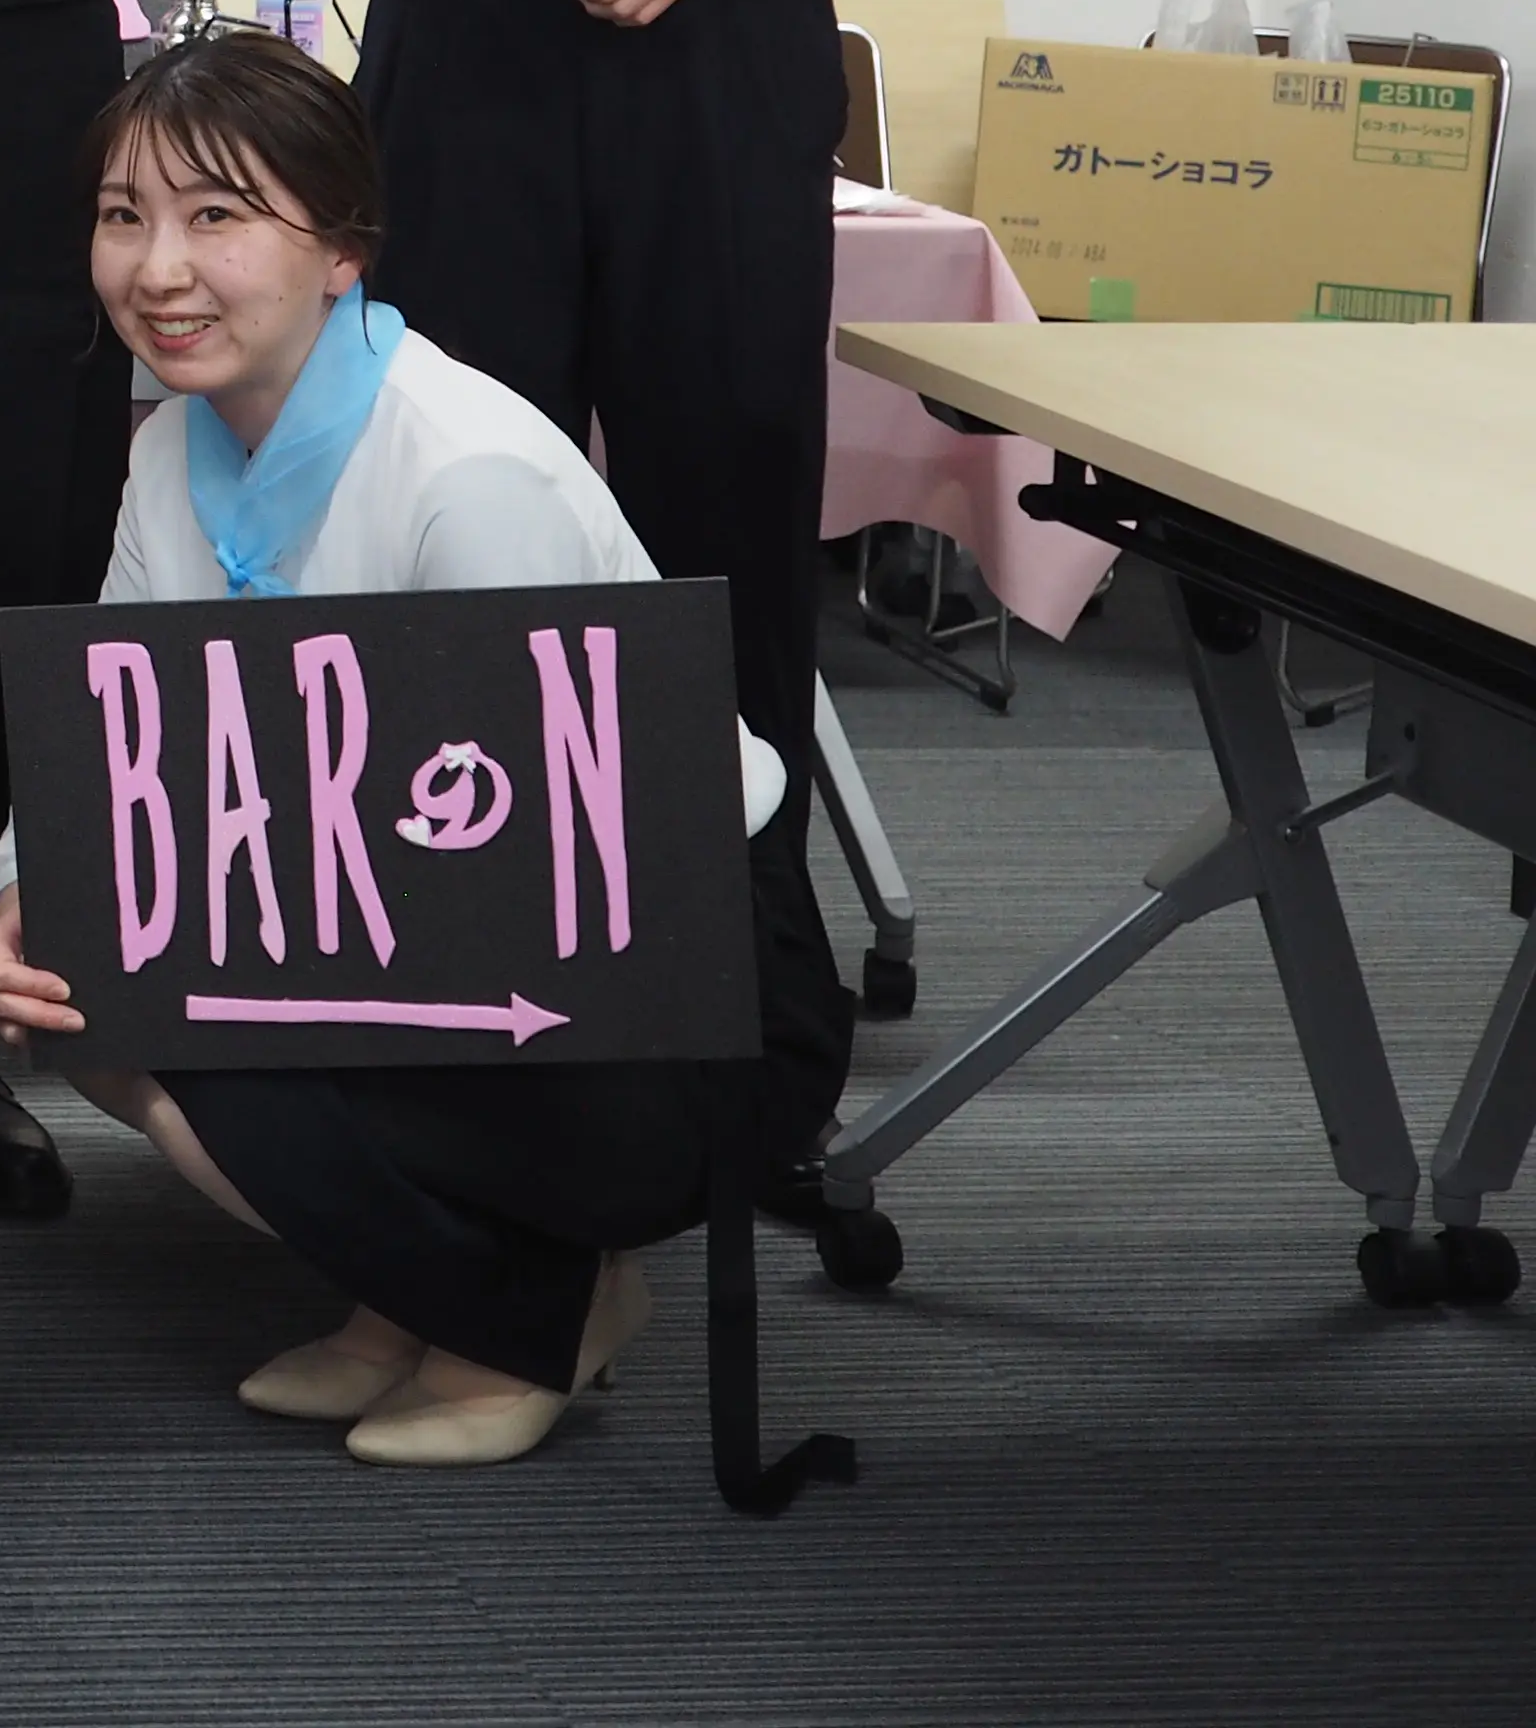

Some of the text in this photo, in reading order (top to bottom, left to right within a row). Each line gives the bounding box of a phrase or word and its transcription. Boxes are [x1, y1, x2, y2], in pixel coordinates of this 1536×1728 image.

[1378, 84, 1456, 109] 25110
[1053, 144, 1274, 189] ガトーショコラ
